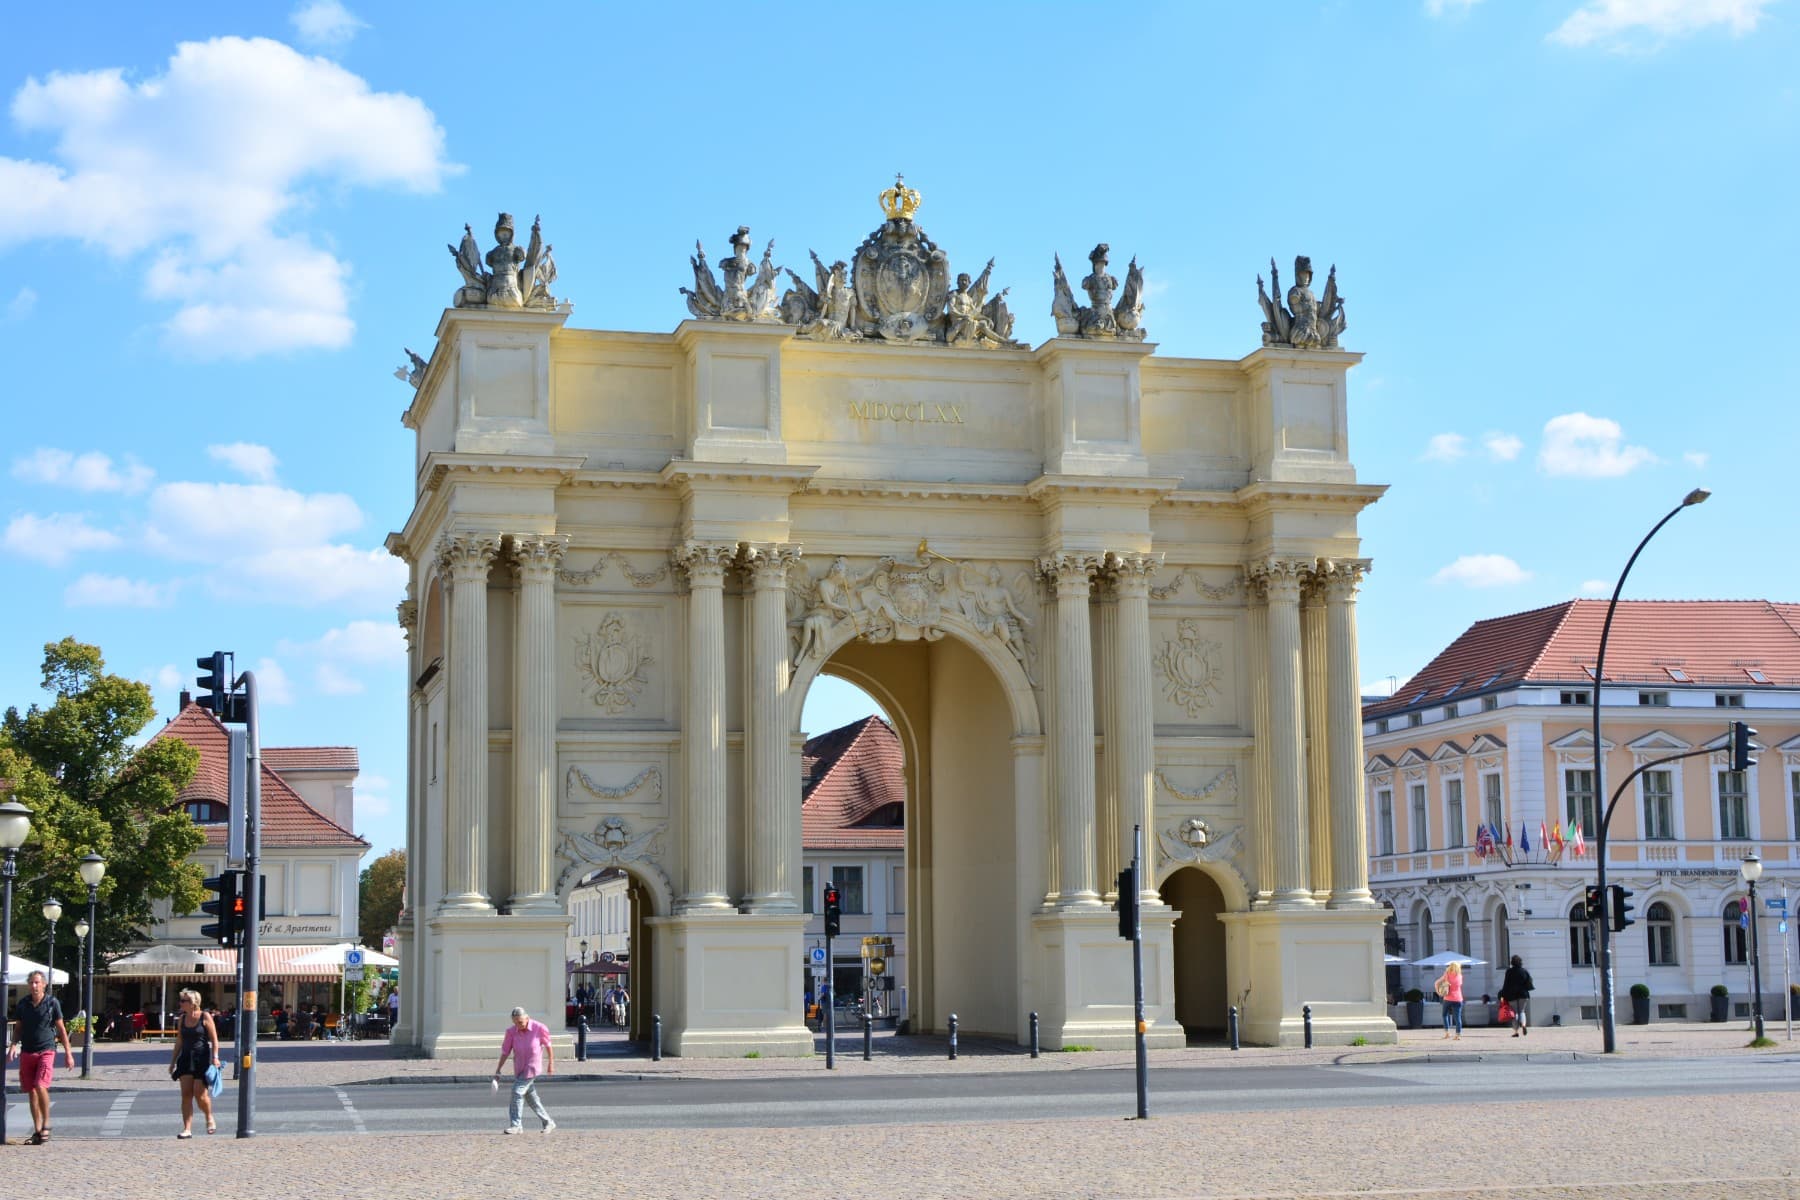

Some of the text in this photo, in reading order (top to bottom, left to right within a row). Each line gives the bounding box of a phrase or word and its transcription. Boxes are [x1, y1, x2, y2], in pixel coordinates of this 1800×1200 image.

[848, 400, 965, 424] MDCCLXX
[259, 922, 273, 936] afé
[285, 924, 332, 935] Apartments
